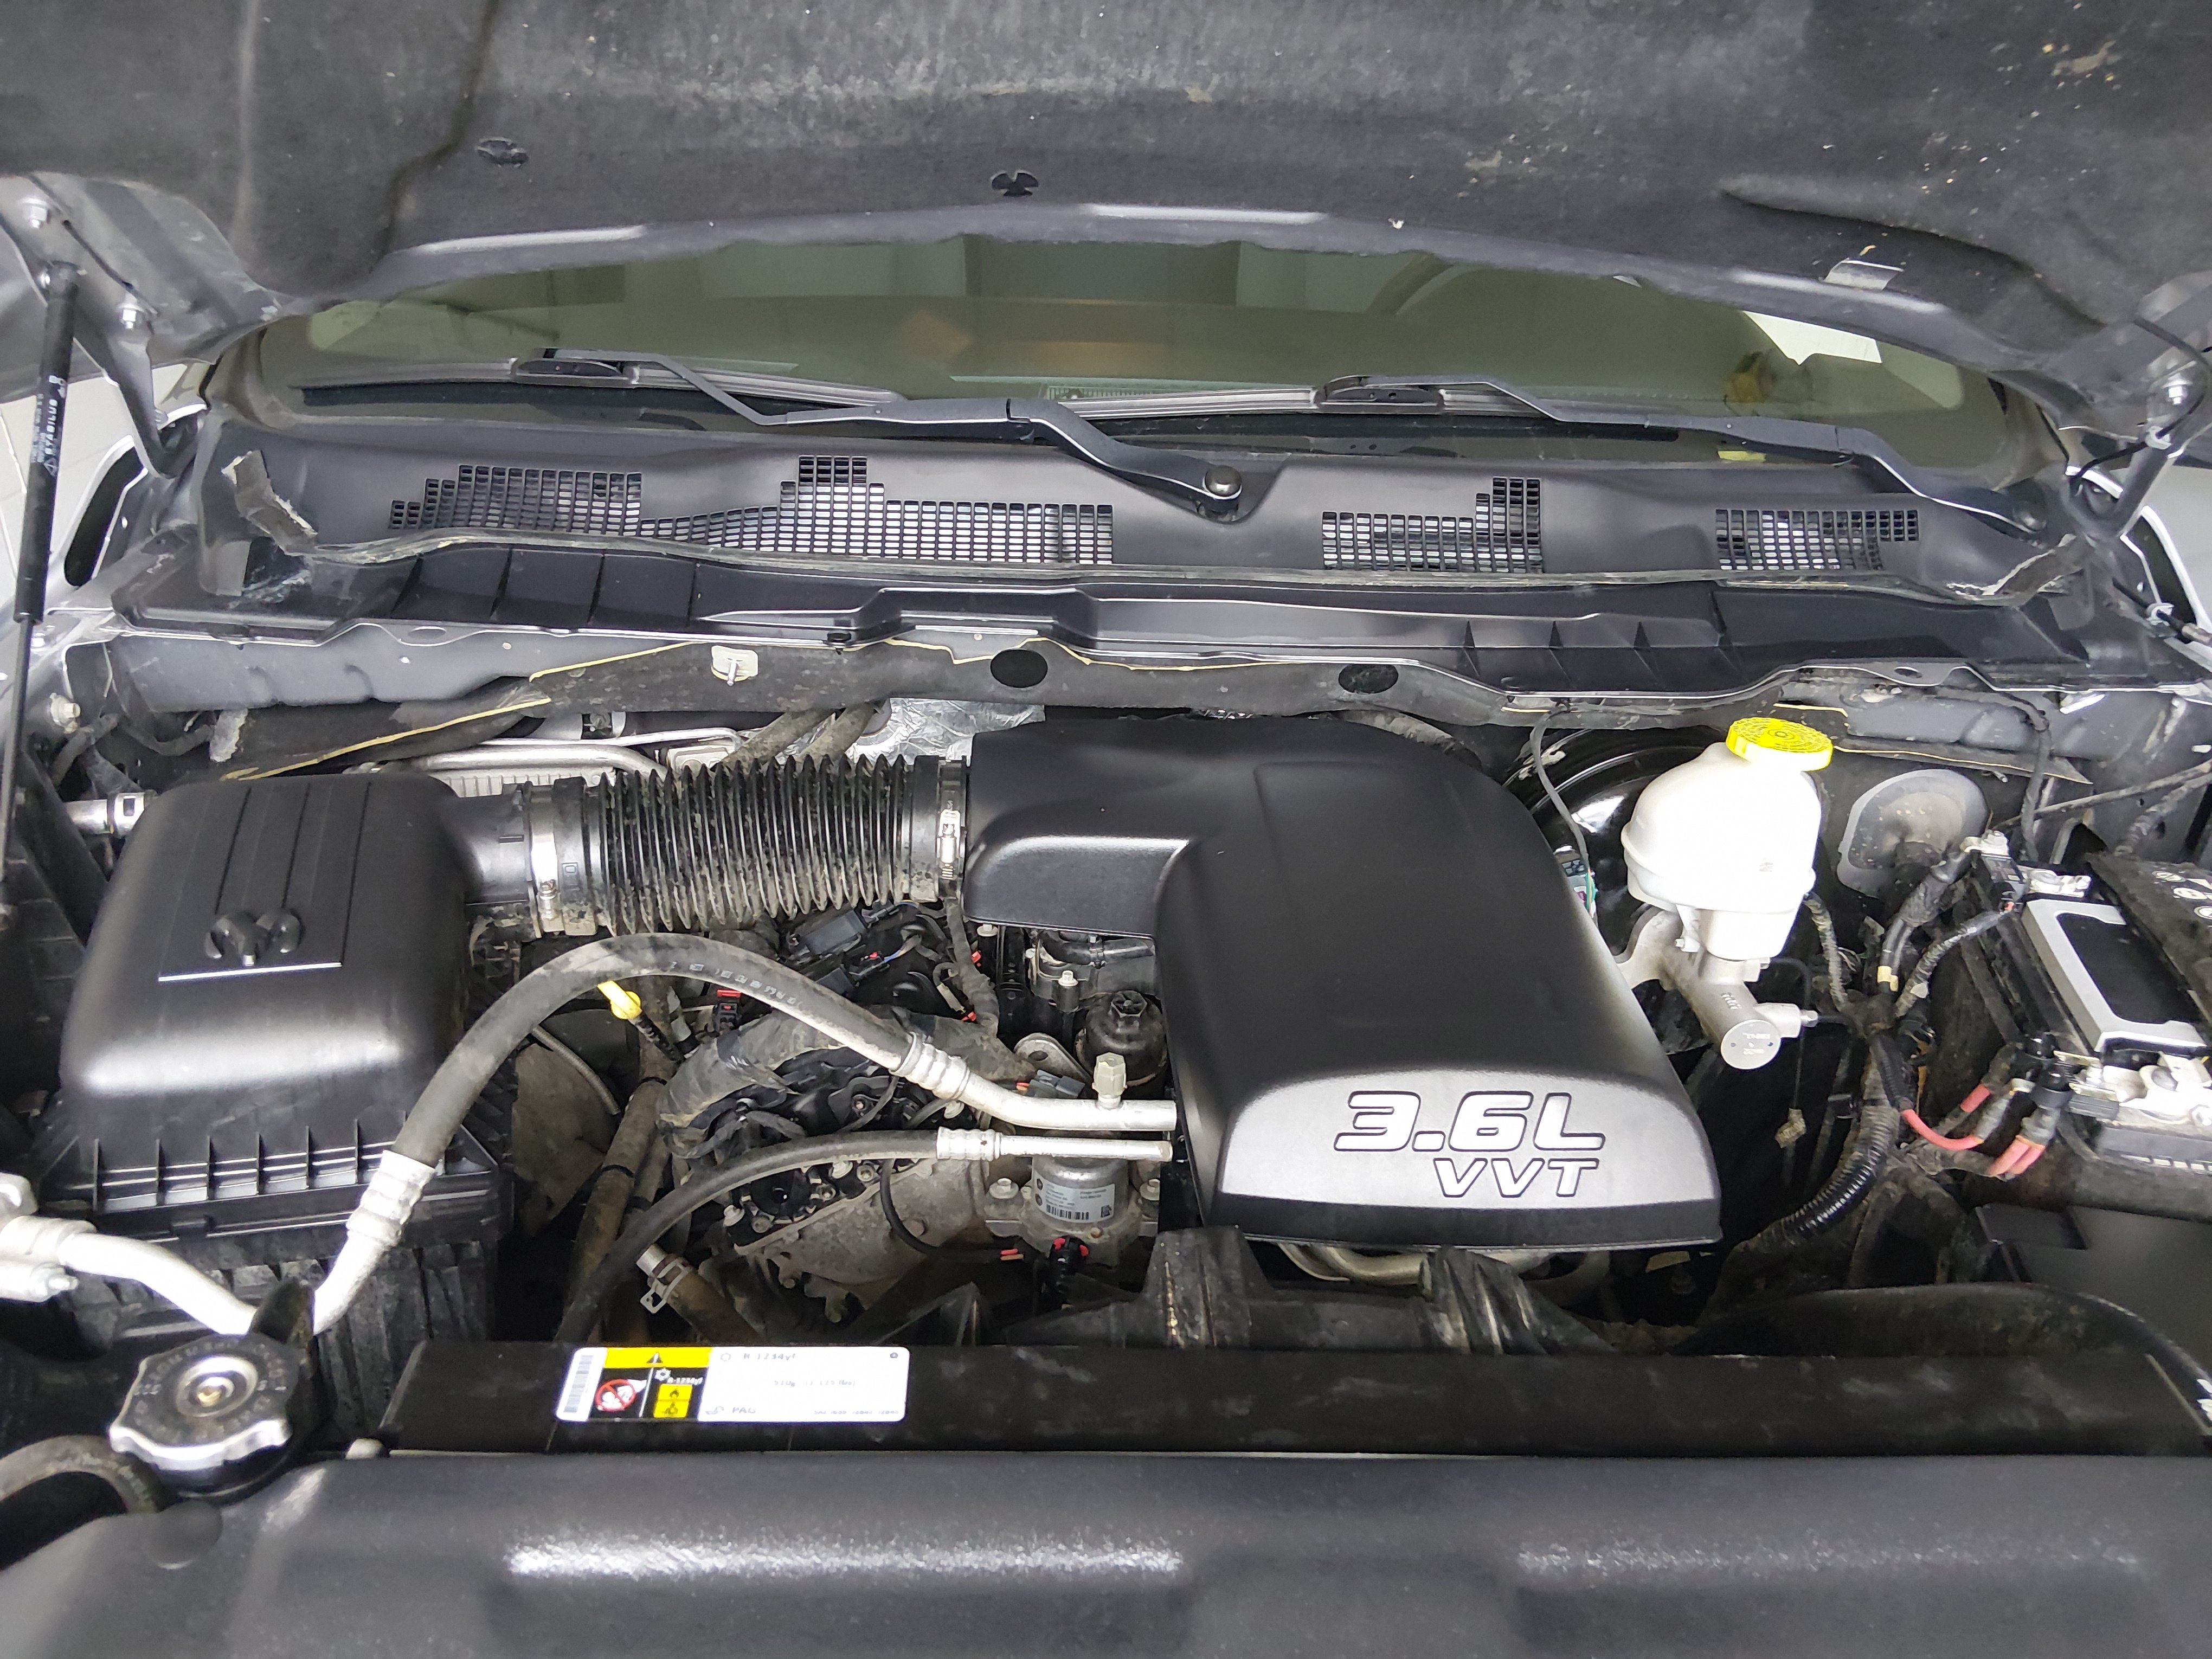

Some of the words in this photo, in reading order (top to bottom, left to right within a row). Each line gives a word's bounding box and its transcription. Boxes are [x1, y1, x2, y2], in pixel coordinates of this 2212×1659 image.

[1334, 1090, 1606, 1152] 3.6L
[1433, 1158, 1600, 1198] VVT
[743, 1353, 796, 1361] R1234yf
